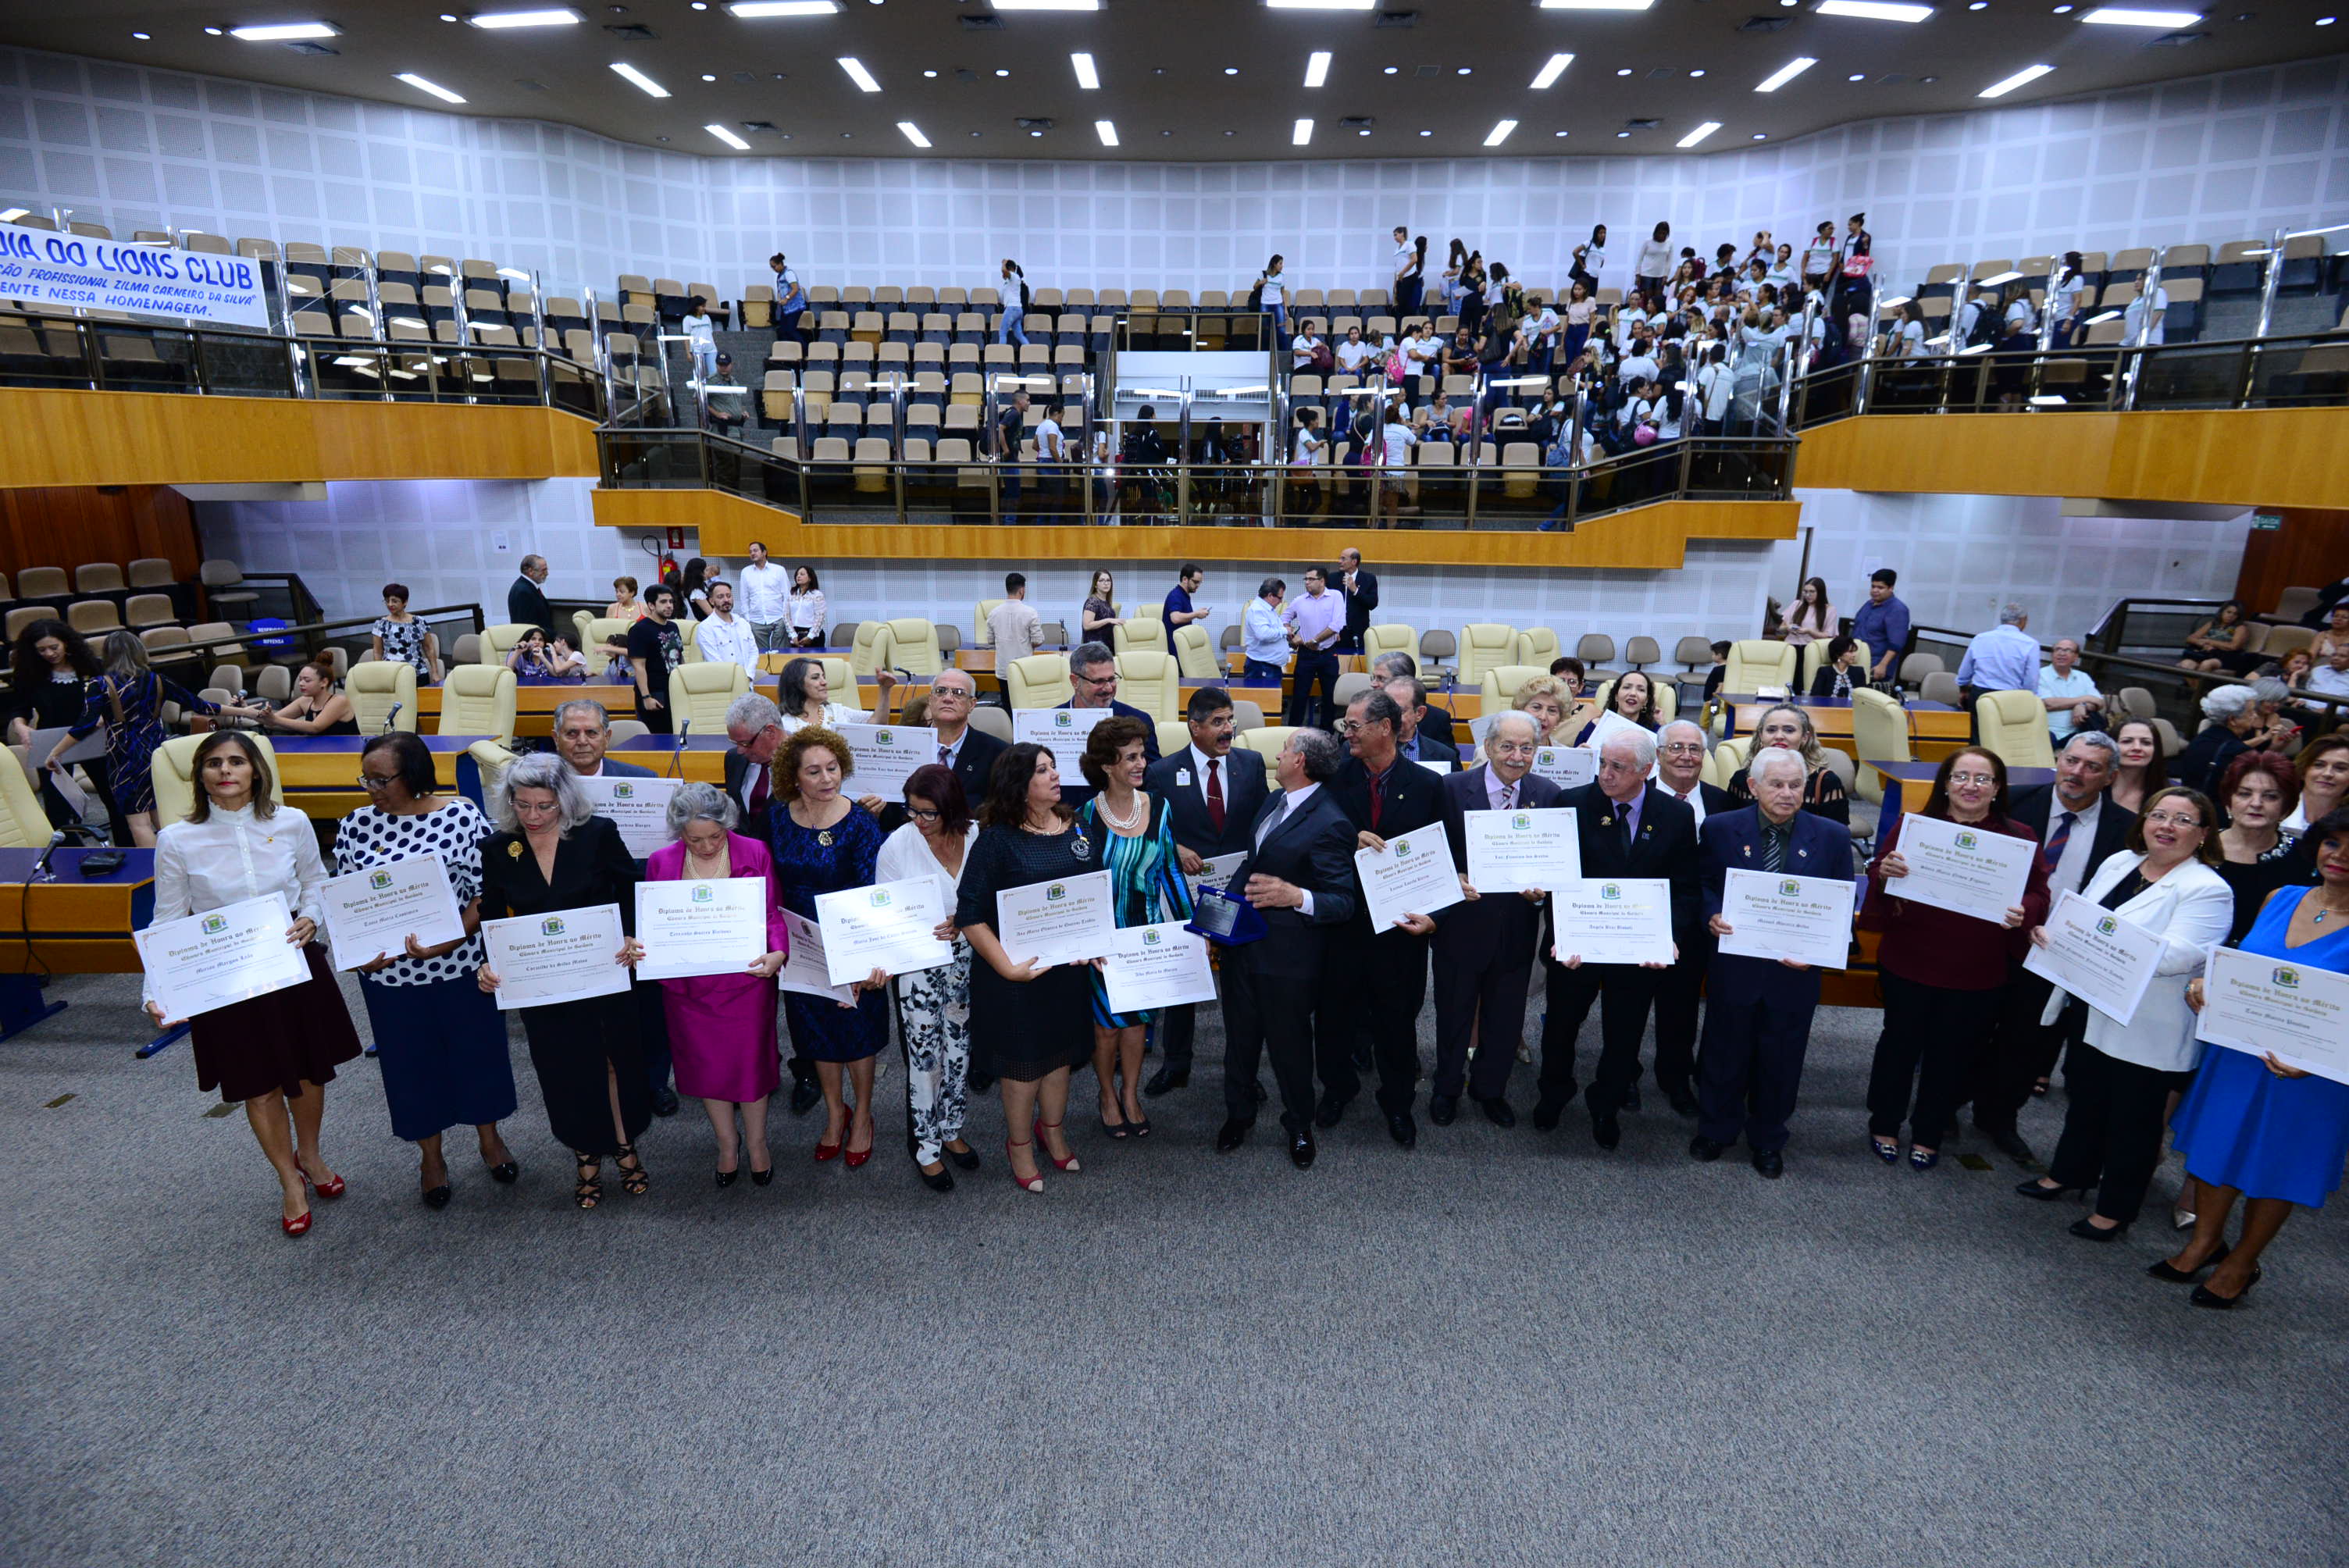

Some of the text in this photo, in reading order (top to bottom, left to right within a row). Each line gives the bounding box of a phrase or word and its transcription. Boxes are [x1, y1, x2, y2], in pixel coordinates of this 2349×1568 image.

[46, 238, 87, 267] DO
[96, 245, 179, 280] LIONS
[185, 257, 253, 290] CLUB
[28, 269, 108, 288] PROFISSIONAL
[114, 280, 149, 294] ZILMA
[152, 285, 204, 301] CARNEIRO
[209, 291, 222, 302] DA
[48, 287, 95, 303] NESSA
[105, 294, 212, 316] HOMENAGEM.
